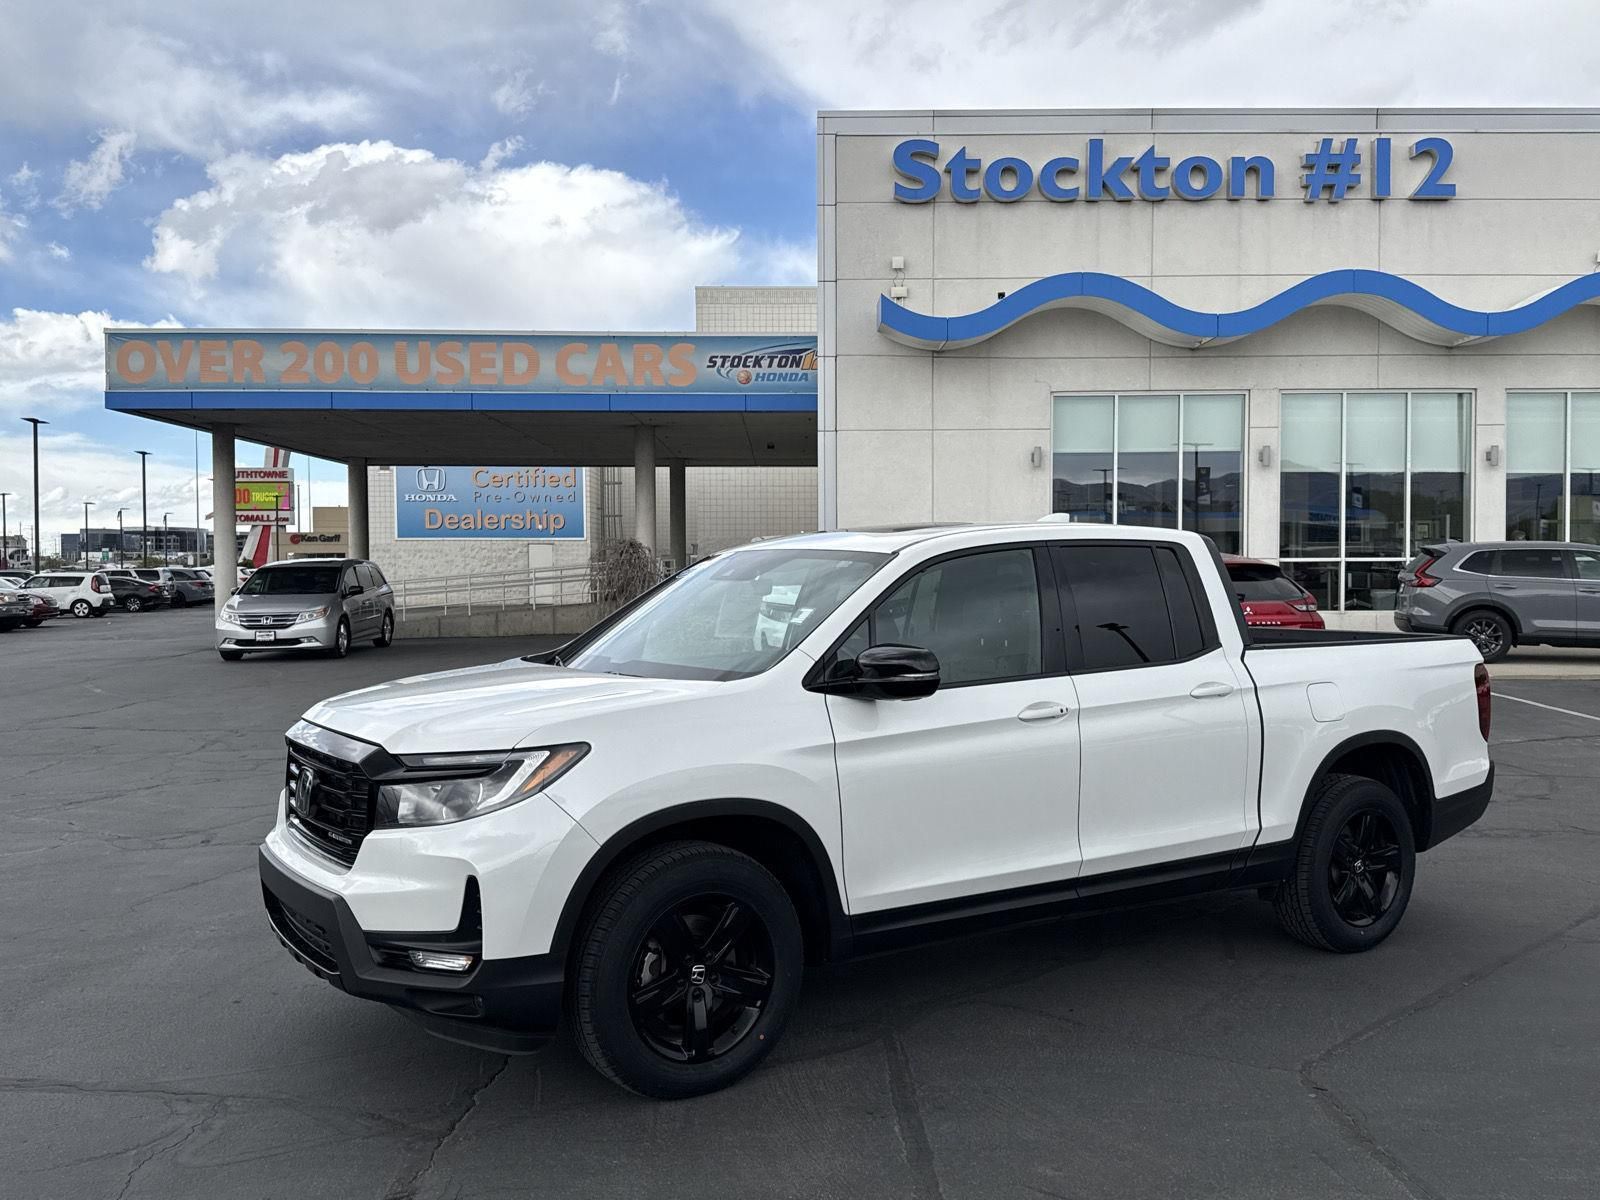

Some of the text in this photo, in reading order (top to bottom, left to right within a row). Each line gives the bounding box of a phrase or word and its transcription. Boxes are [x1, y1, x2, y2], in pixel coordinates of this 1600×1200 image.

[892, 137, 1457, 203] Stockton #12
[116, 339, 697, 387] OVER 200 USED CARS
[707, 355, 804, 369] STOCKTON
[754, 372, 809, 382] HONDA
[472, 467, 577, 488] Certified
[405, 494, 457, 502] HONDA
[474, 491, 576, 503] Pre-Owned
[424, 508, 566, 534] Dealership
